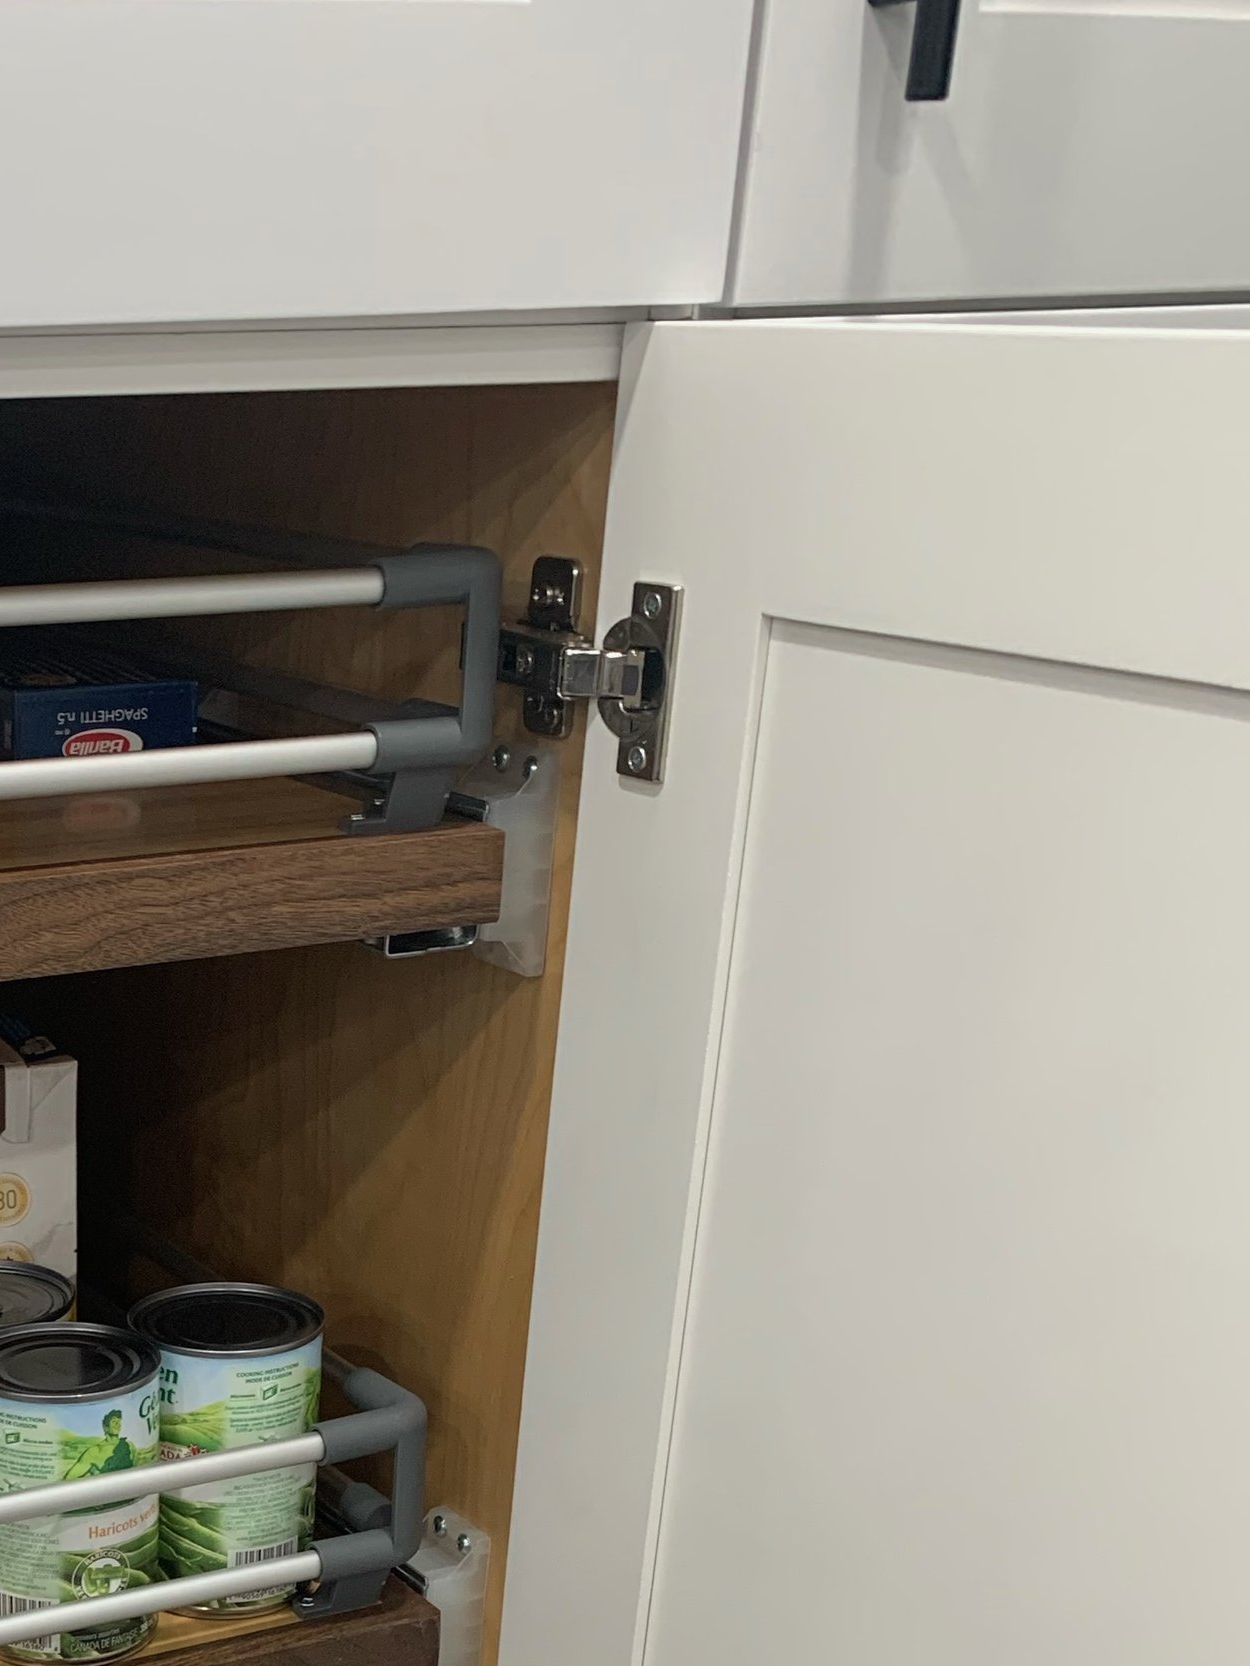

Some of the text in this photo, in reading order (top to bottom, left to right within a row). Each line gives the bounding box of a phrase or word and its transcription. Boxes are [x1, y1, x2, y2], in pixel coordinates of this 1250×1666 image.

[81, 707, 148, 724] SPAGHETTI
[88, 1514, 139, 1541] Haricots
[69, 1636, 101, 1653] CANADA
